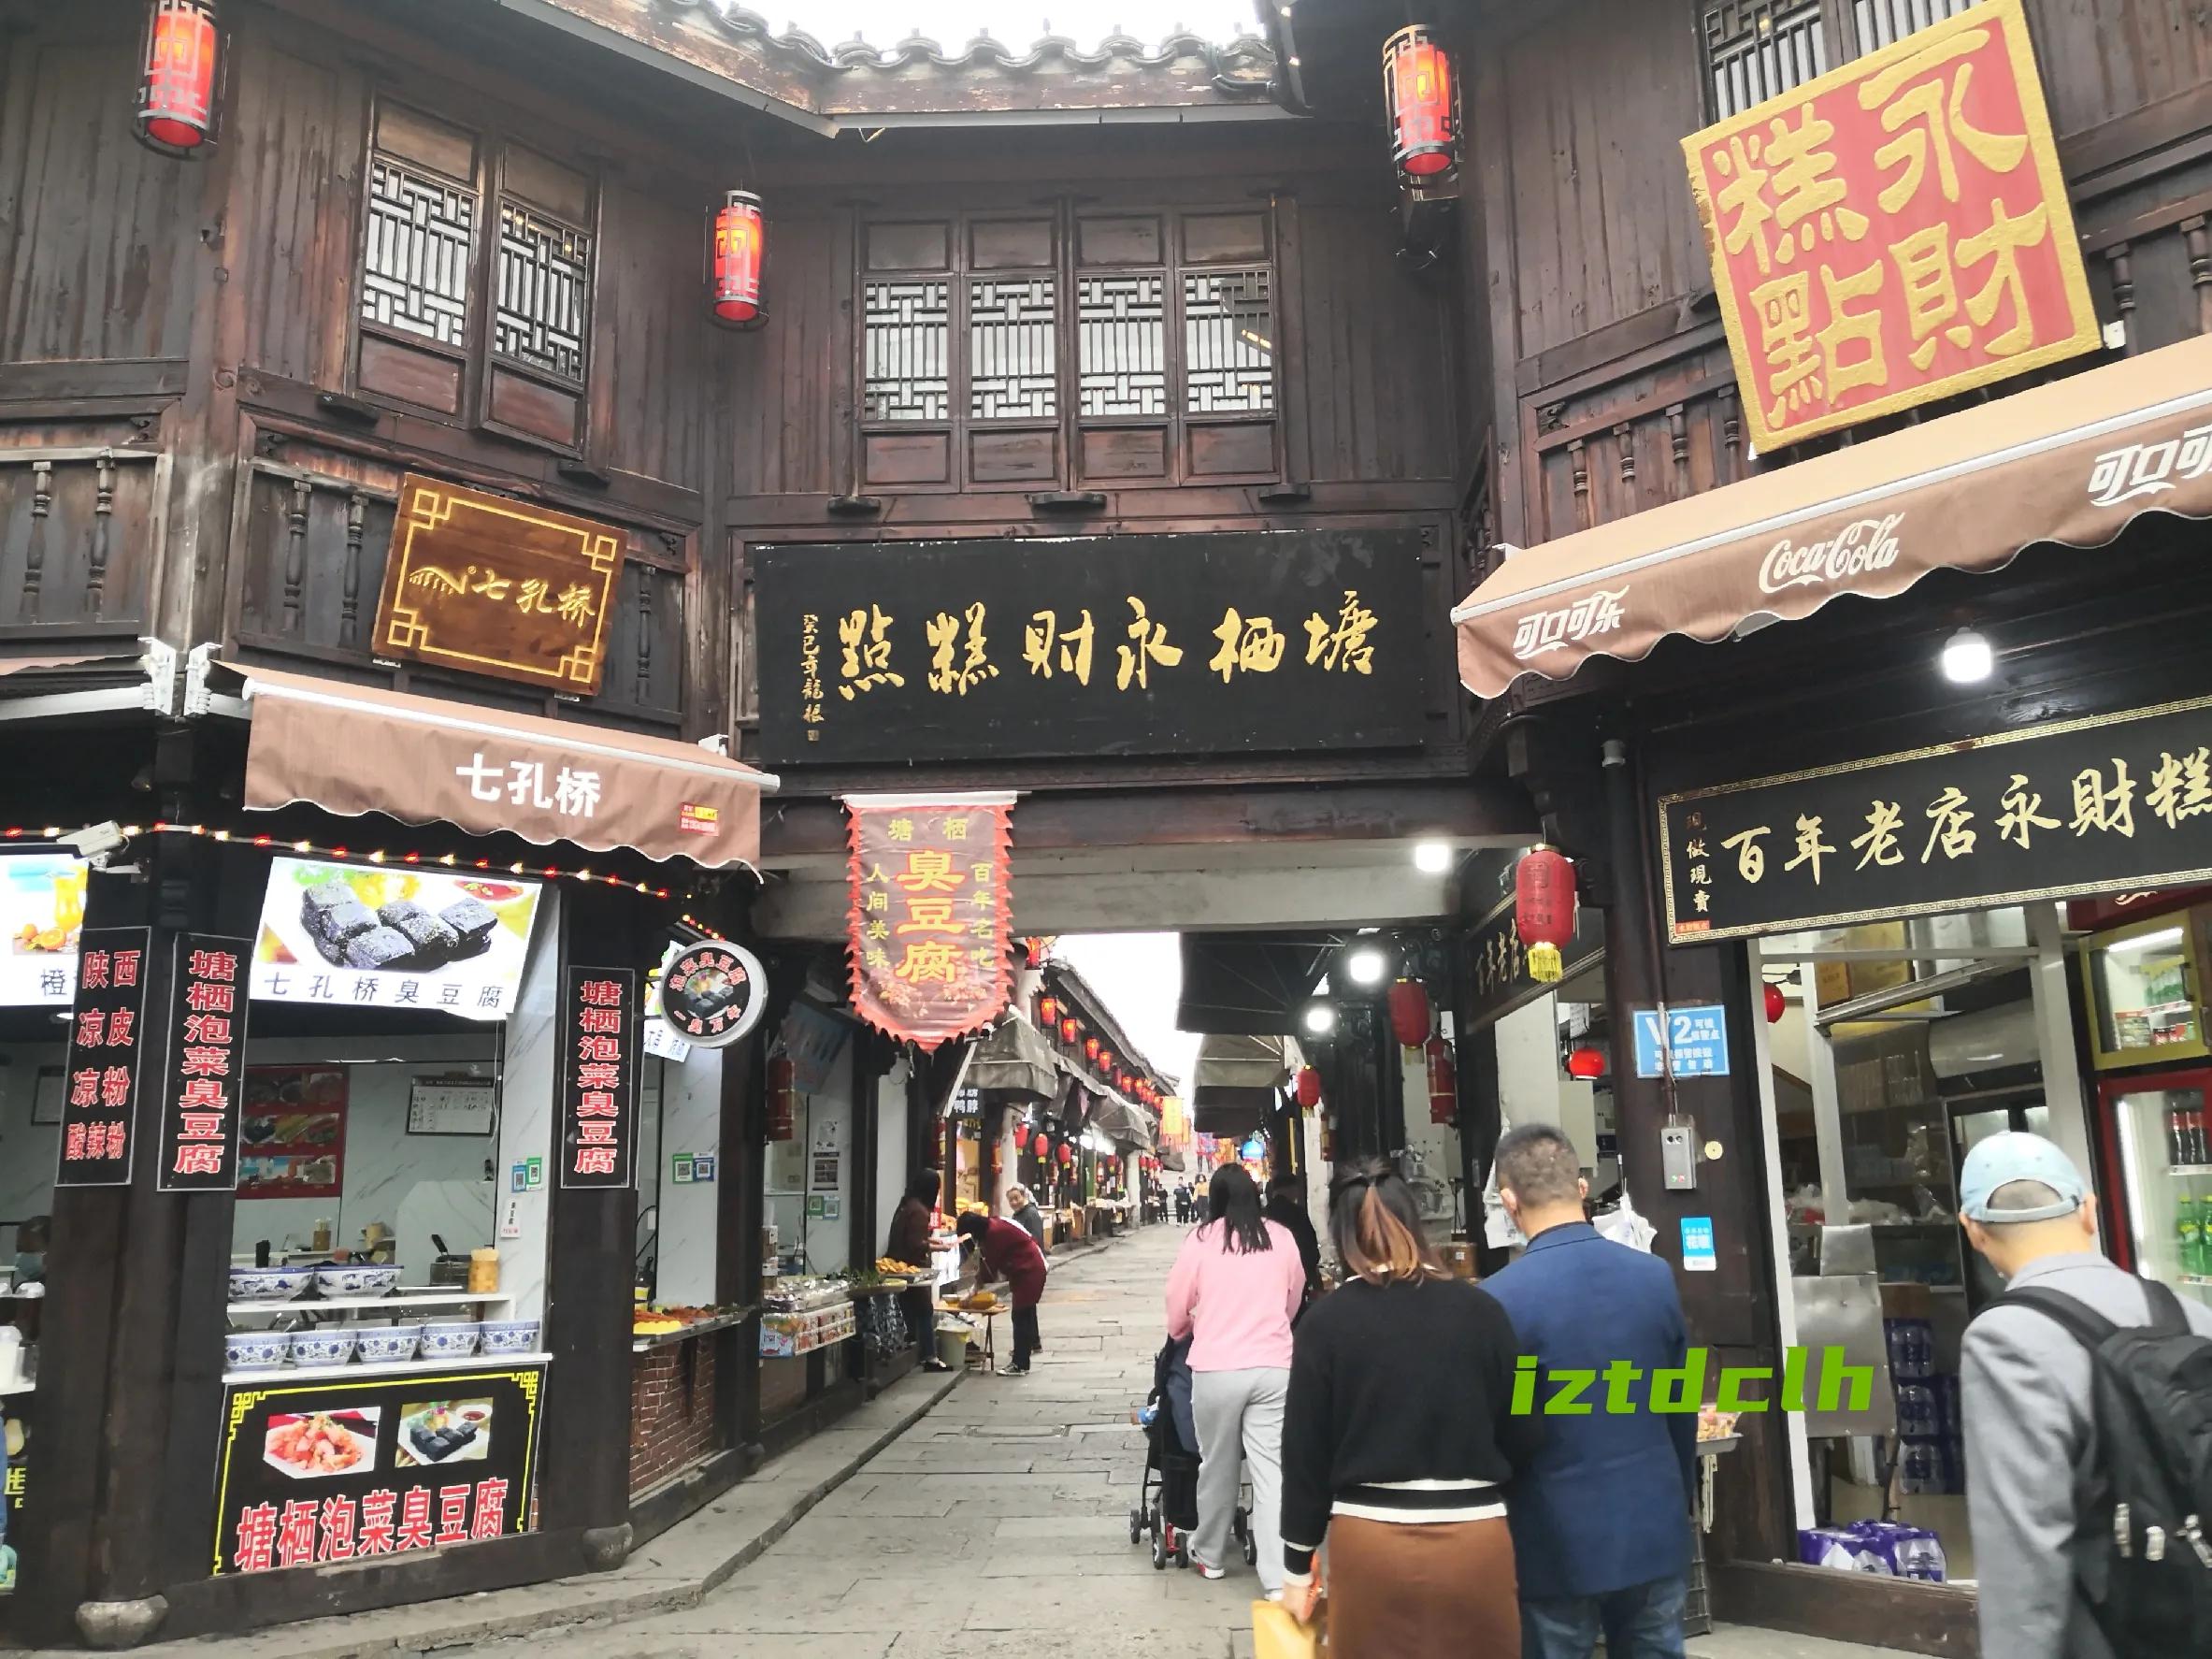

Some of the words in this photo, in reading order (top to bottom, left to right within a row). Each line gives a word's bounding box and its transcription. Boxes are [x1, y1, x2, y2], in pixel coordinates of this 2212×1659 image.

[2088, 423, 2212, 507] 可口可
[1513, 584, 1630, 660] 可口可乐
[455, 752, 601, 818] 七孔桥
[888, 816, 968, 841] 塘栖
[866, 862, 890, 969] 人间美味
[896, 849, 965, 984] 臭豆腐
[970, 862, 995, 968] 百年名吃
[40, 967, 79, 997] 橙
[81, 949, 141, 989] 陕西
[265, 971, 504, 1009] 七孔桥臭豆腐
[76, 1006, 135, 1047] 凉皮
[70, 1065, 131, 1108] 凉粉
[172, 950, 238, 1175] 塘栖泡菜臭豆腐
[574, 980, 624, 1175] 塘栖泡菜臭豆腐
[65, 1120, 126, 1161] 酸辣粉
[234, 1477, 510, 1572] 塘栖泡菜臭豆腐
